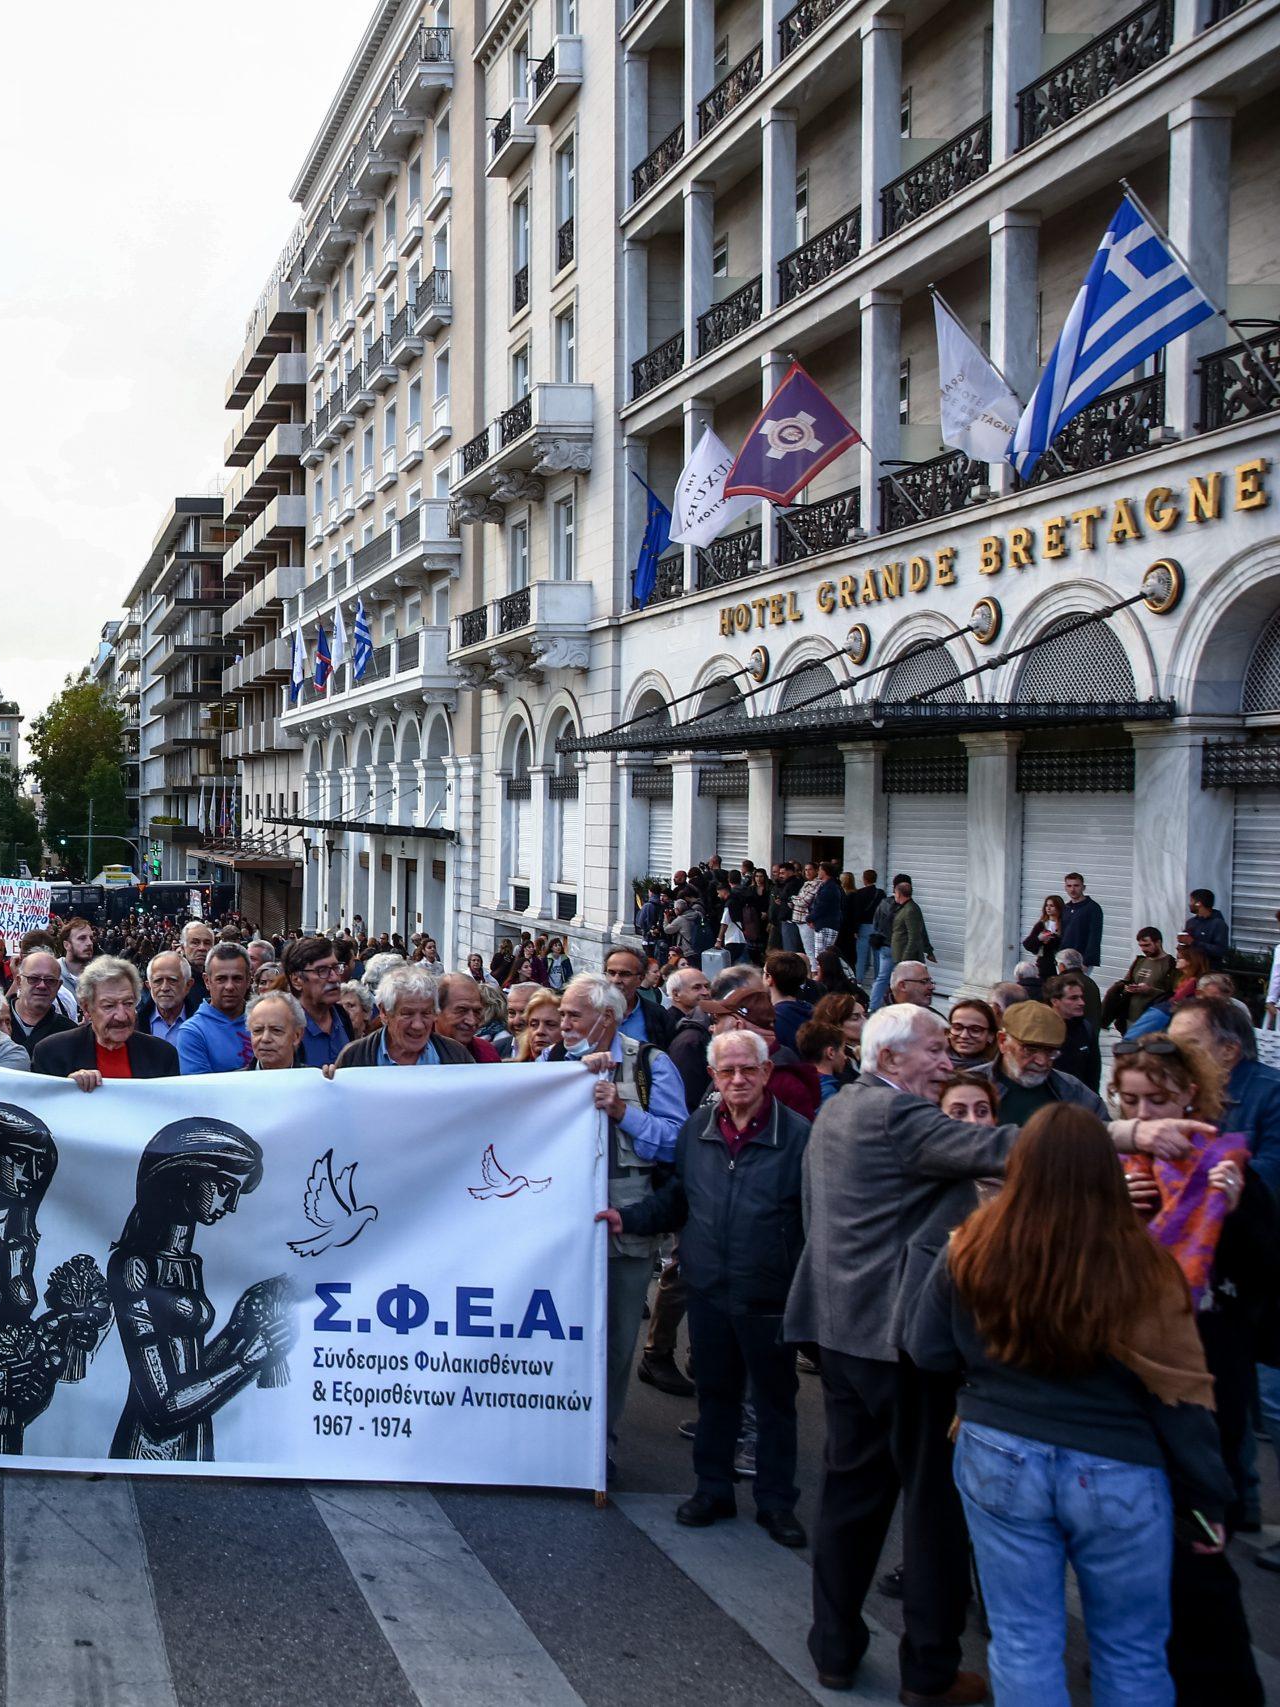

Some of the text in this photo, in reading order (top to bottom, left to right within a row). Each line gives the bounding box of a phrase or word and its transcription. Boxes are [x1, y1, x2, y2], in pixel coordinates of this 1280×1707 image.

[719, 457, 1268, 636] HOTEL GRANDE BRETAGNE
[17, 905, 49, 916] ΞΥΠΝΑ!
[19, 914, 47, 924] ΚΥΠΡΟ
[313, 1282, 584, 1340] Σ.Φ.Ε.Α.
[312, 1346, 554, 1376] Σύνδεσμος Φυλακισθέντων
[312, 1380, 592, 1412] & Εξορισθέντων Αντιστασιακών
[313, 1415, 352, 1436] 1967
[371, 1417, 412, 1438] 1974
